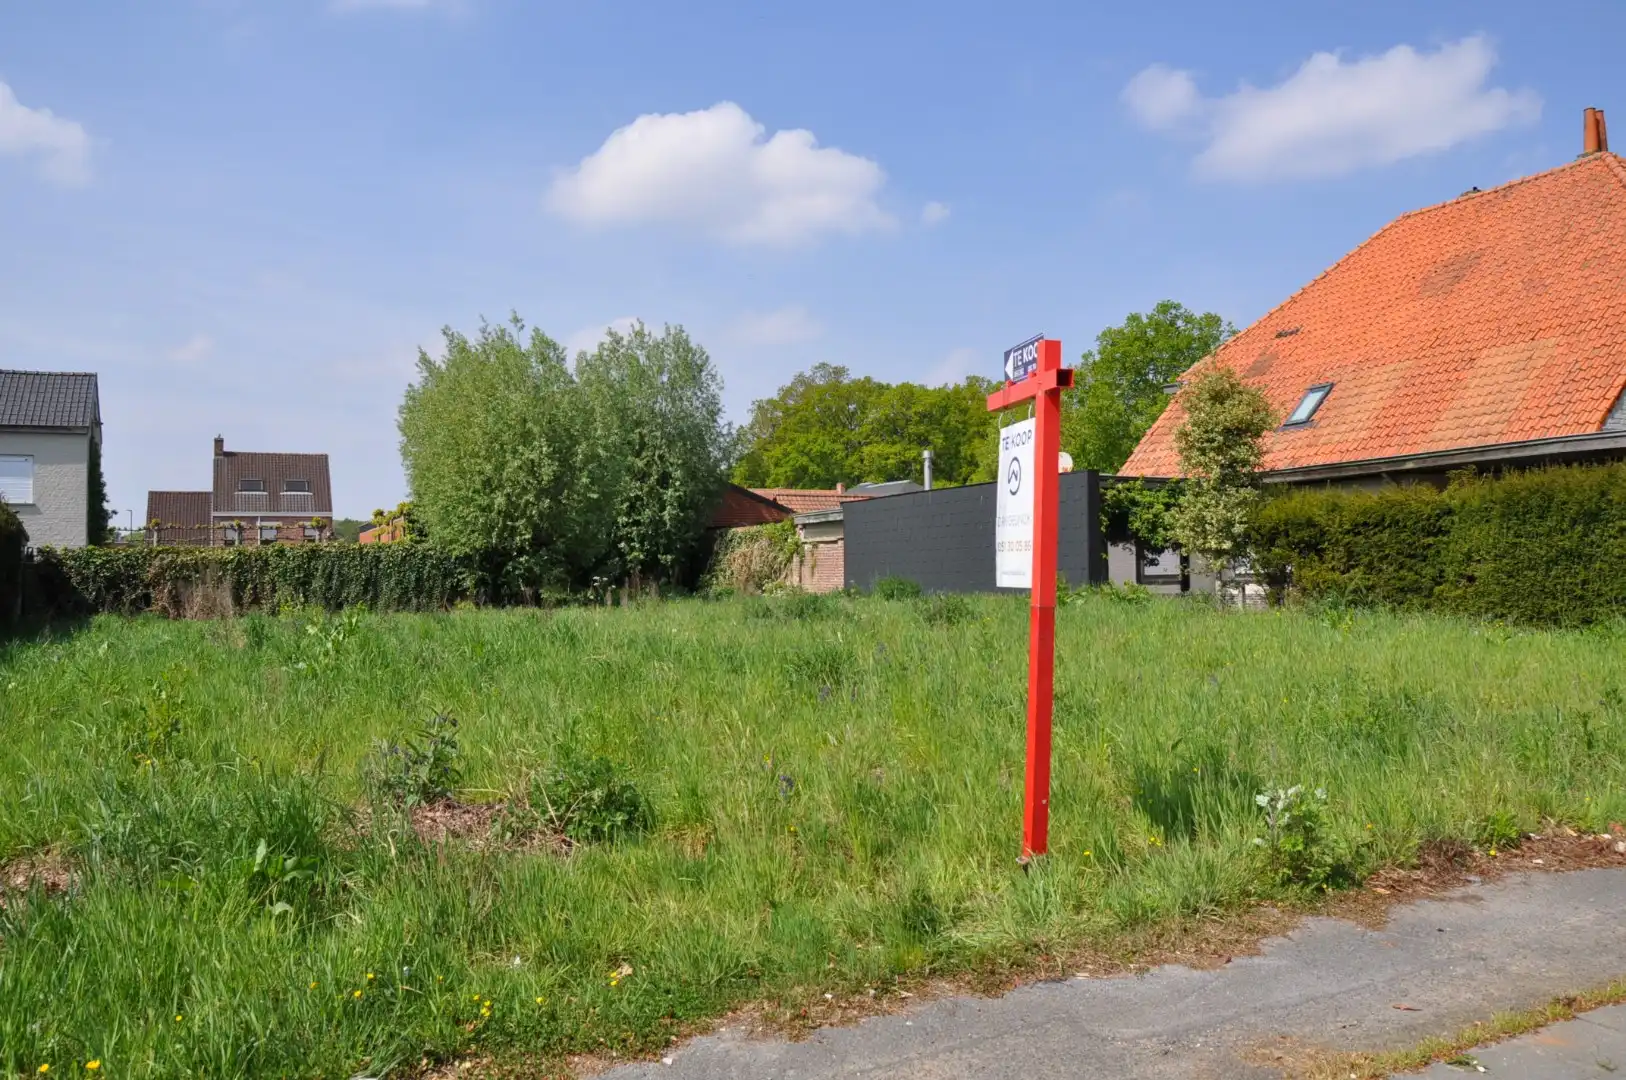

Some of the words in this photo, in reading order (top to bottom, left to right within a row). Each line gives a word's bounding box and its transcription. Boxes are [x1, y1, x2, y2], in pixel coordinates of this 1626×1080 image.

[1013, 350, 1022, 367] TE
[1022, 341, 1038, 363] KOO
[1002, 436, 1010, 451] TE
[1011, 429, 1032, 449] KOOP
